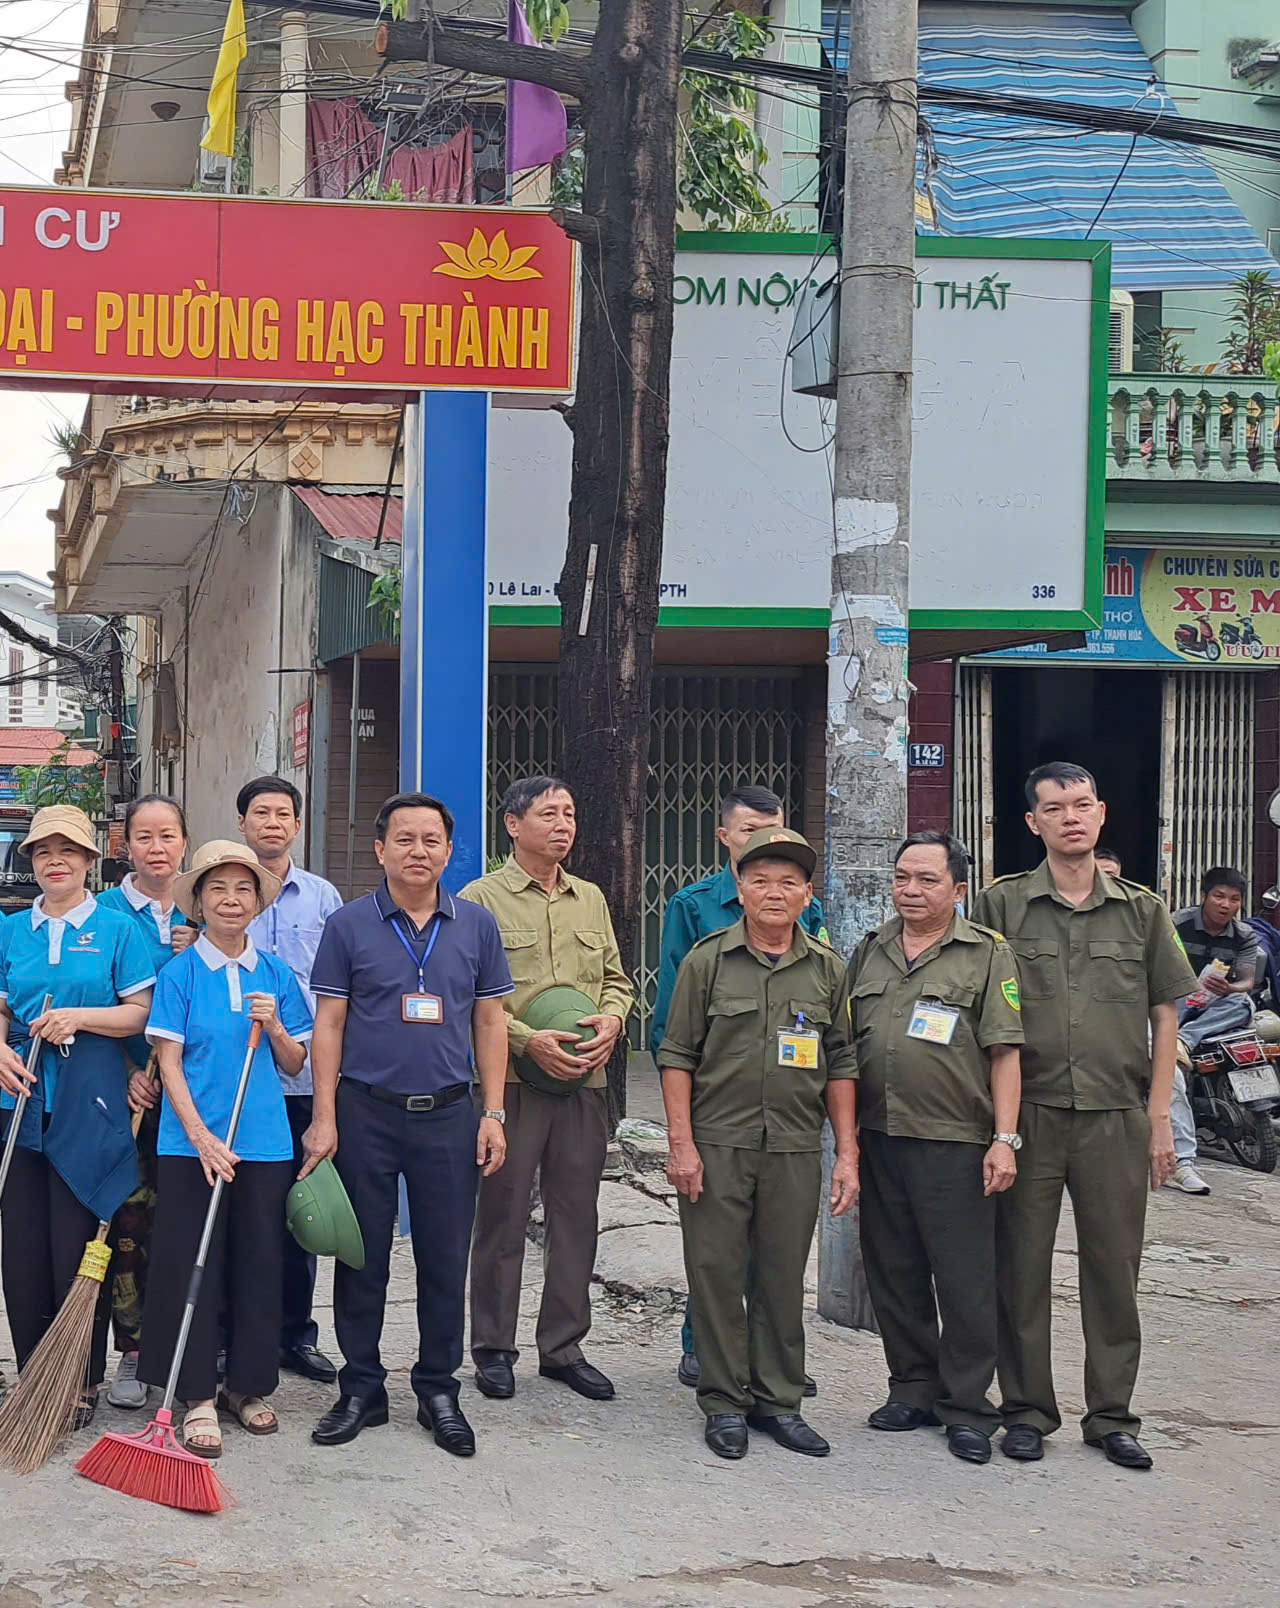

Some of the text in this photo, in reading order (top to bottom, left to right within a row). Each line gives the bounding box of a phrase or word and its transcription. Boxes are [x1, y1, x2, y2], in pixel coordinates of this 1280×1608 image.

[34, 206, 120, 252] CƯ
[934, 272, 1012, 310] THẤT
[66, 316, 83, 331] -
[95, 280, 280, 362] PHƯỜNG
[296, 298, 384, 376] HẠC
[400, 291, 550, 370] THÀNH
[1104, 556, 1134, 597] nh
[1163, 555, 1228, 577] CHUYÊN
[1233, 554, 1264, 577] SỬA
[500, 581, 516, 595] Lê
[522, 582, 541, 596] Lai
[1032, 585, 1055, 598] 336
[1172, 587, 1237, 612] XE
[913, 745, 941, 760] 142
